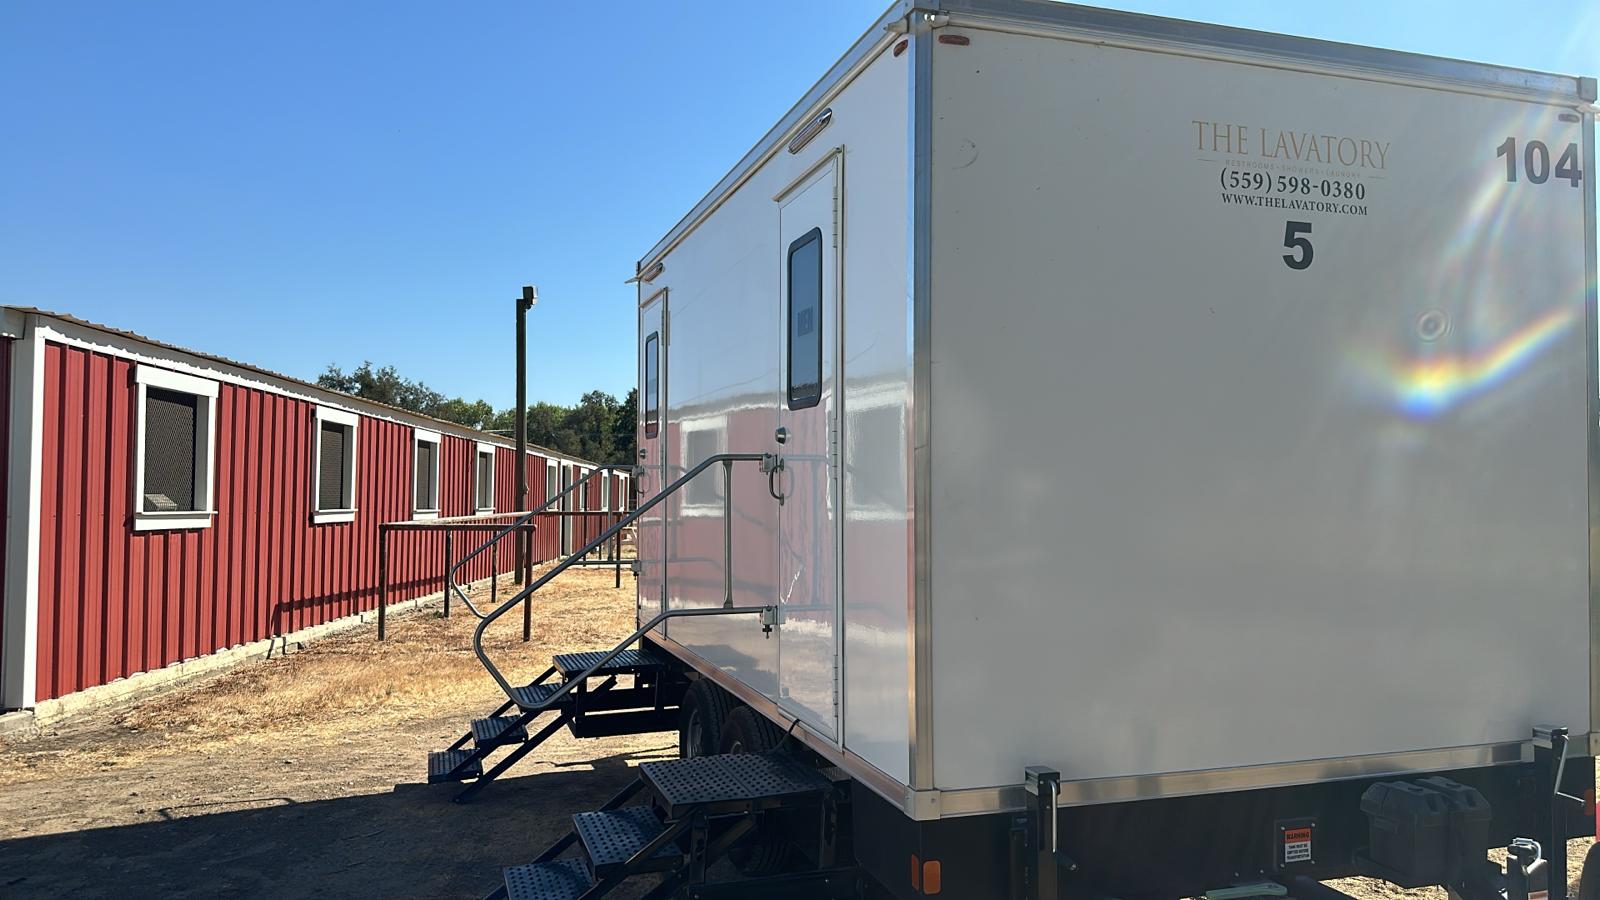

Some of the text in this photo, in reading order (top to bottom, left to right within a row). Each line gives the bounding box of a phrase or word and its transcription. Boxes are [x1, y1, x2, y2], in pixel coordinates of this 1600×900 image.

[1192, 120, 1391, 170] THE LAVATORY
[1496, 136, 1583, 188] 104
[1221, 193, 1368, 215] WWW.THELAVATORY.COM
[1282, 220, 1314, 270] 5
